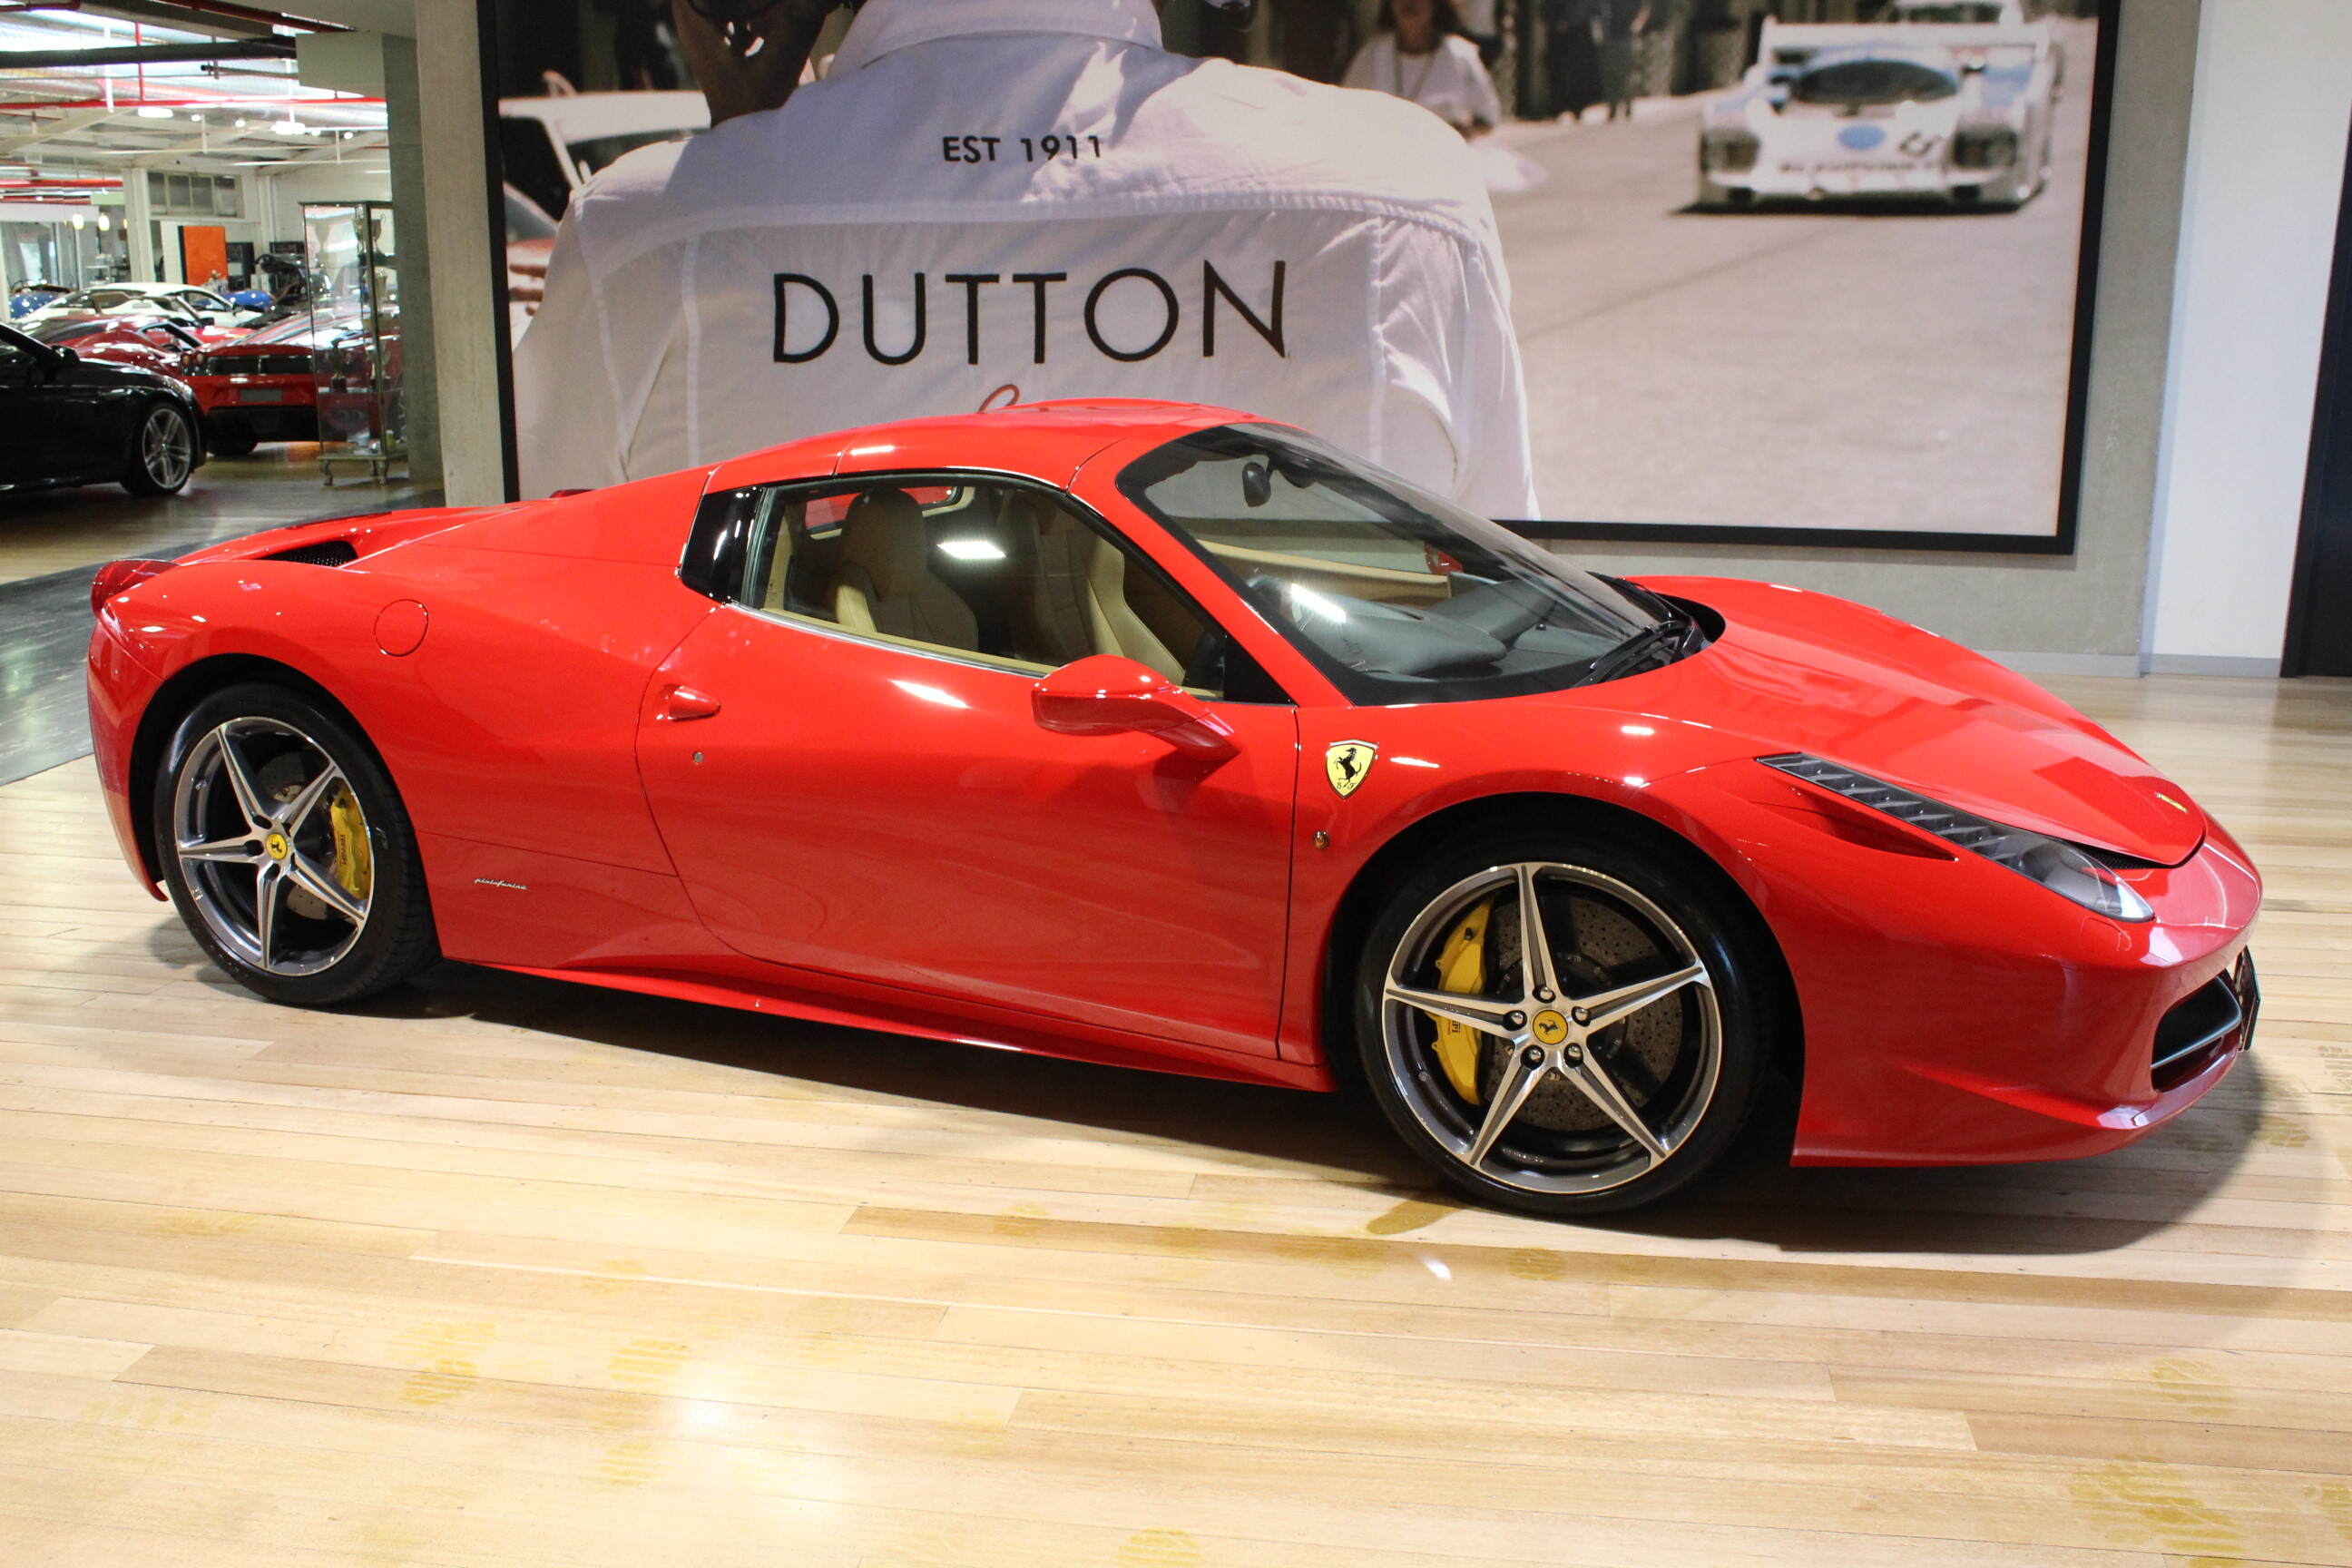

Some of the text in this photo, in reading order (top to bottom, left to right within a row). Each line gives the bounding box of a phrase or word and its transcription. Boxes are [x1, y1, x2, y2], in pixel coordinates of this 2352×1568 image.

[943, 135, 1101, 163] EST 1911
[772, 260, 1287, 366] DUTTON
